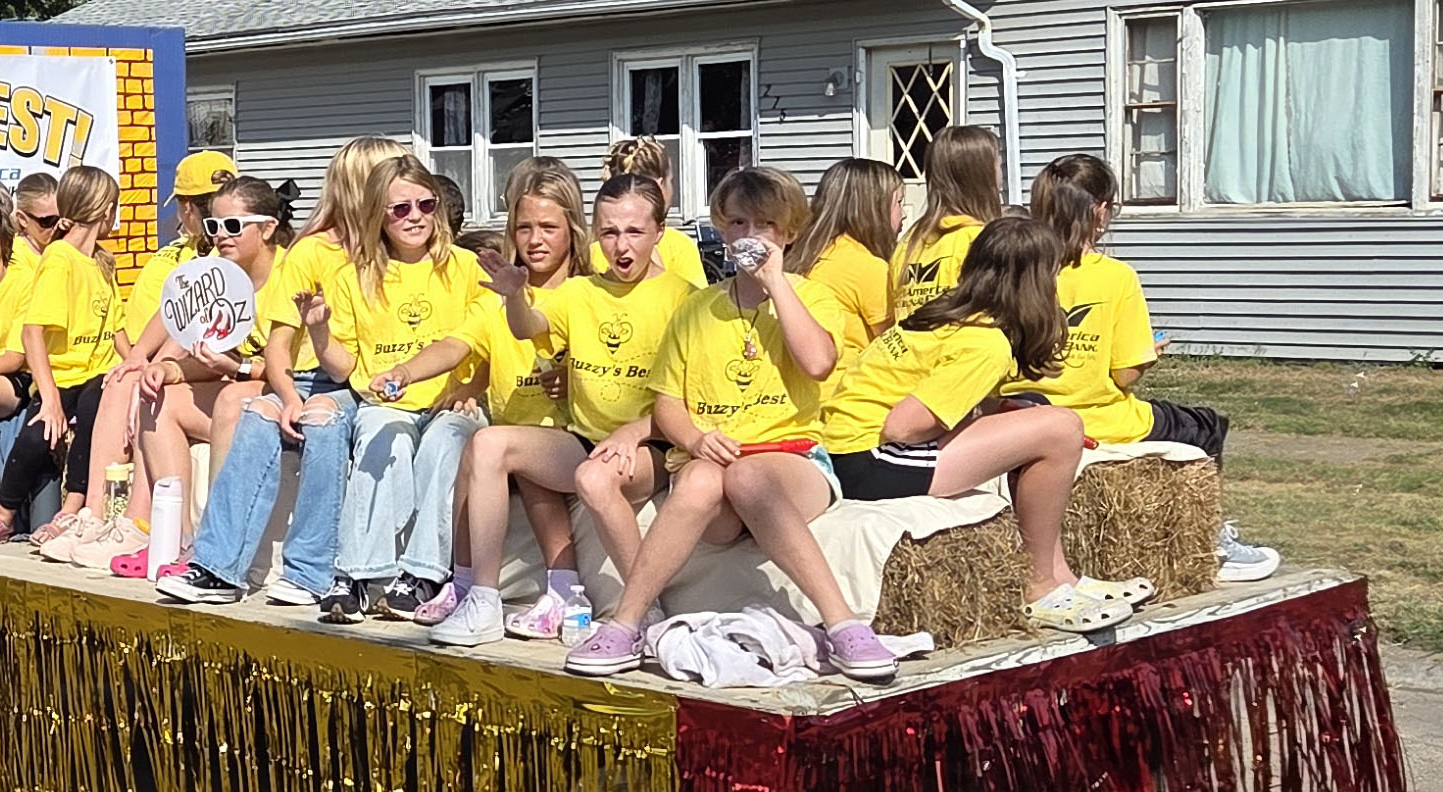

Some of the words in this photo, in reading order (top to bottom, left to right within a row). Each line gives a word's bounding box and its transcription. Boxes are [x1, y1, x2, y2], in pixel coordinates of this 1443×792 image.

[164, 267, 226, 331] WIZARD
[200, 307, 211, 324] of
[374, 339, 425, 355] Buzzy's
